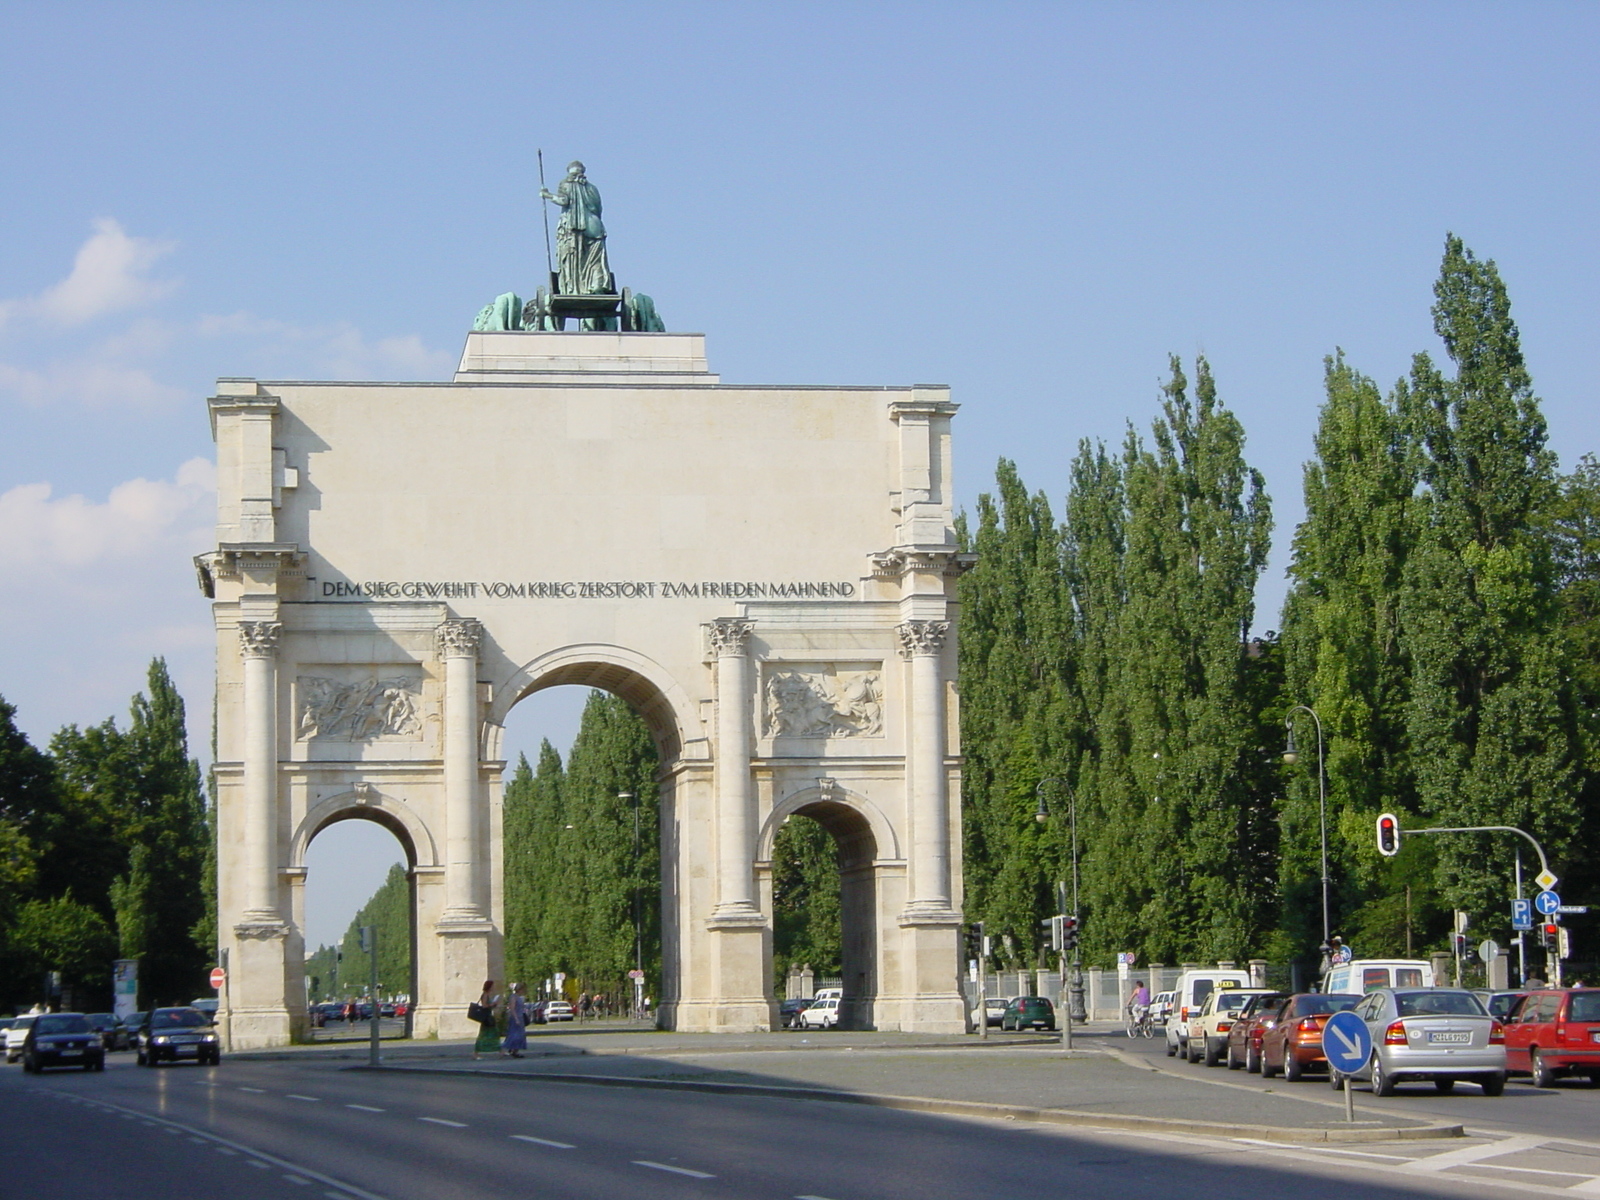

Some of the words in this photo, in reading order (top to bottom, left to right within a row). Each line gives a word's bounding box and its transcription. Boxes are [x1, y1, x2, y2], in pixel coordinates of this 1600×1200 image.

[322, 581, 362, 597] DEM
[363, 581, 401, 598] SIEG
[401, 581, 479, 599] GEWEIHT
[481, 582, 527, 599] VOM
[528, 582, 577, 599] KRIEG
[578, 580, 655, 599] ZERSTÖRT
[660, 582, 700, 599] ZVM
[702, 582, 768, 599] FRIEDEN
[769, 582, 855, 599] MAHNEND
[1514, 901, 1527, 919] P
